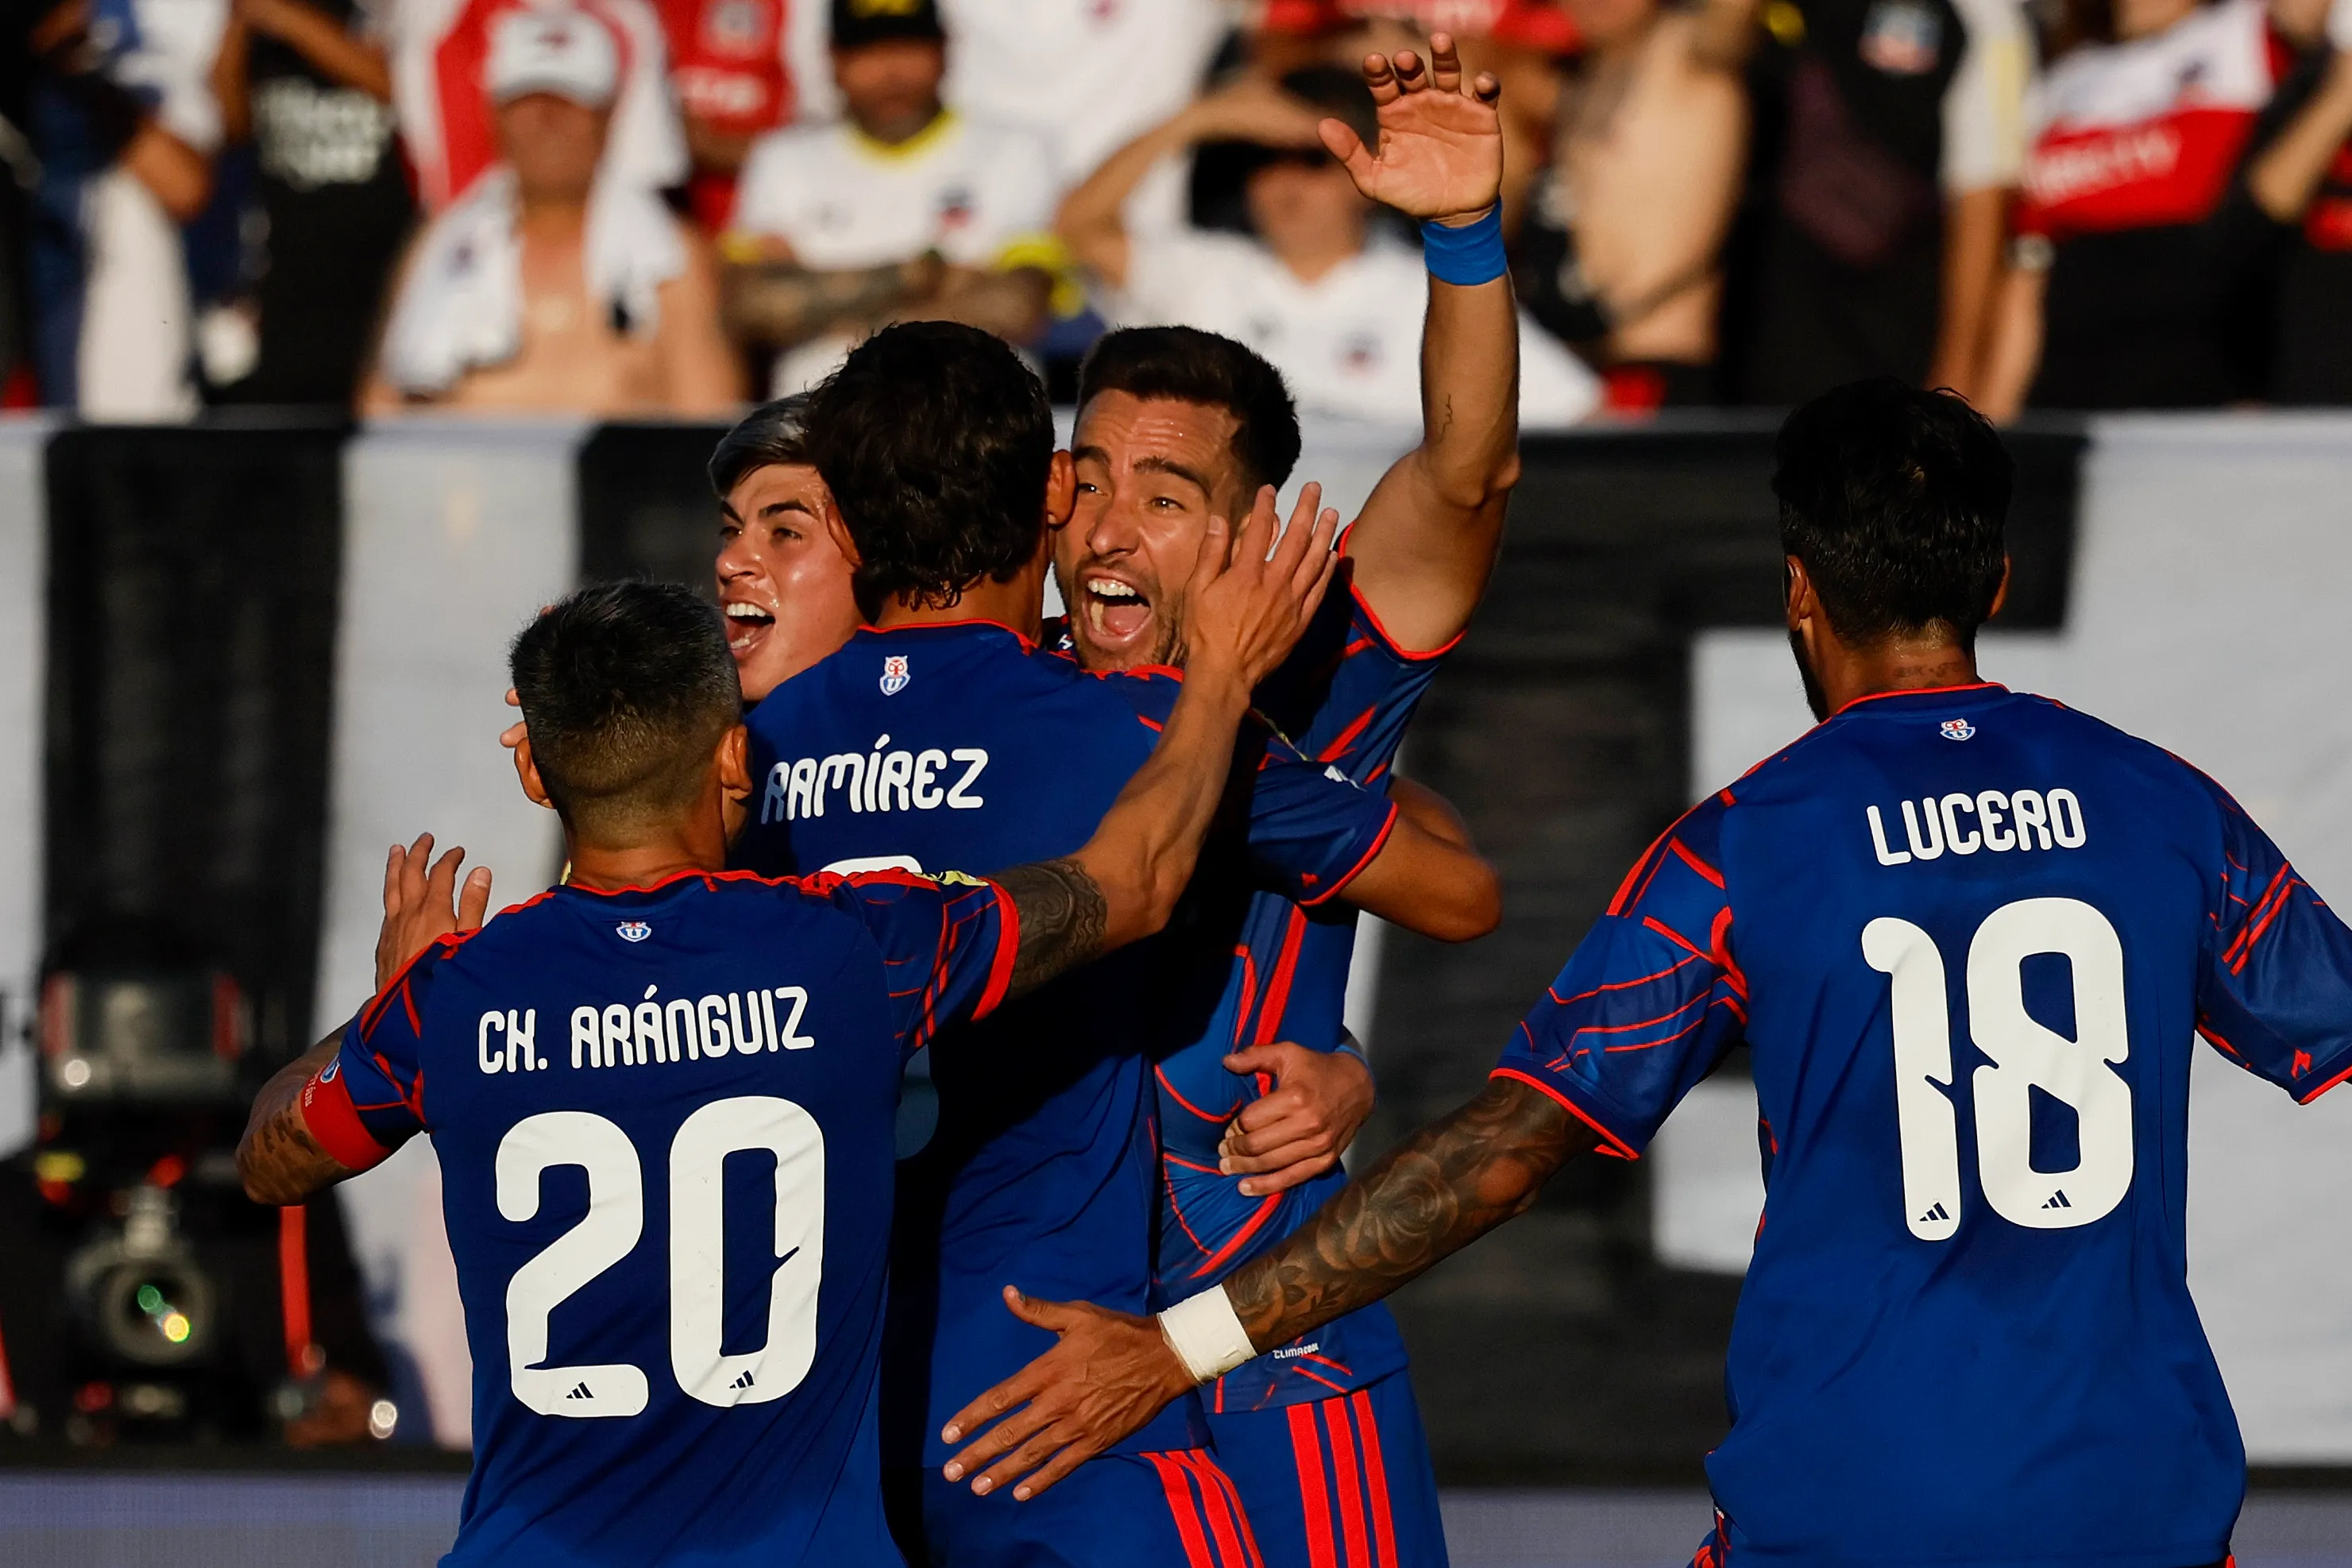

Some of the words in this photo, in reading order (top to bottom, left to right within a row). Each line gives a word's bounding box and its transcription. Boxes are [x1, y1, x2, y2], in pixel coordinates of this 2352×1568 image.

[761, 733, 989, 825] RAMÍREZ
[1866, 788, 2087, 866] LUCERO
[625, 927, 643, 940] U
[478, 1008, 548, 1074] CH.
[570, 983, 815, 1069] ARÁNGUIZ
[1860, 897, 2134, 1241] 18
[495, 1095, 825, 1418] 20
